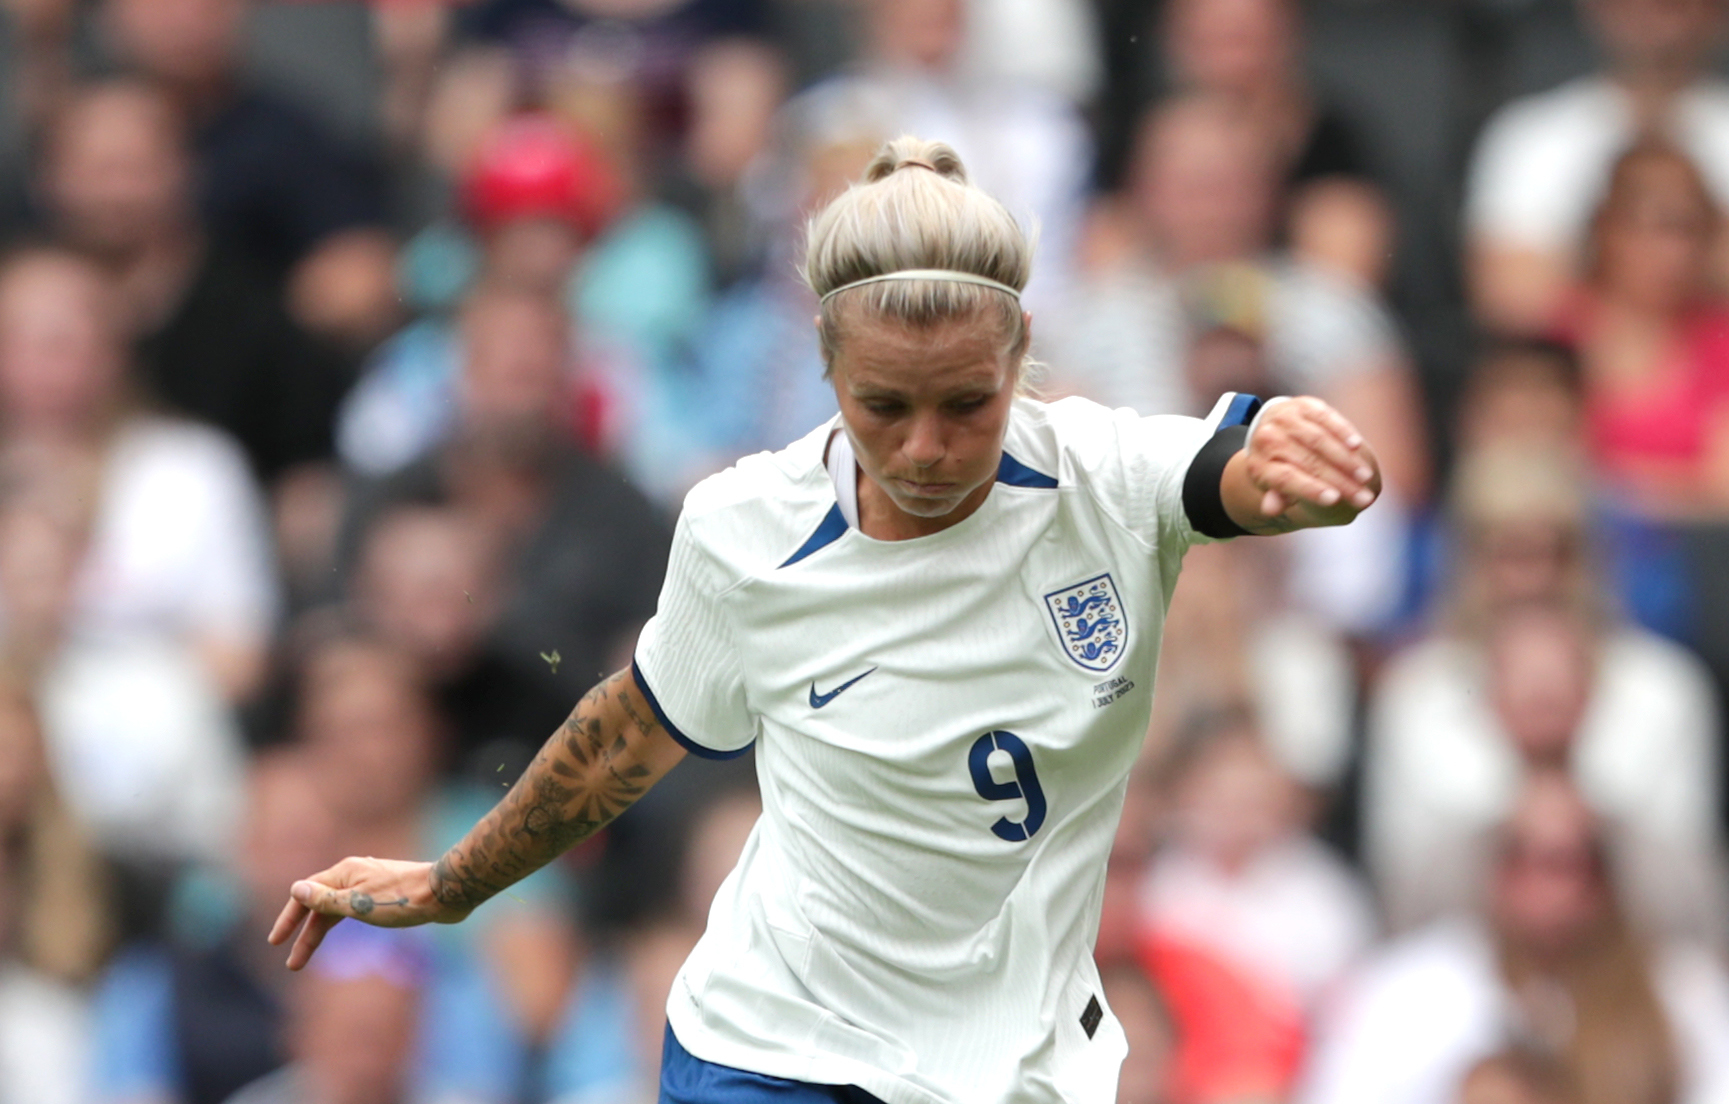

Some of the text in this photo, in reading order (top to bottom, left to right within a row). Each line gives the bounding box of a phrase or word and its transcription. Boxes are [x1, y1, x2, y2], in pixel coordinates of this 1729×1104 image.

[1093, 676, 1128, 694] PORTUGAL
[1097, 694, 1114, 707] JULY
[968, 730, 1047, 842] 9
